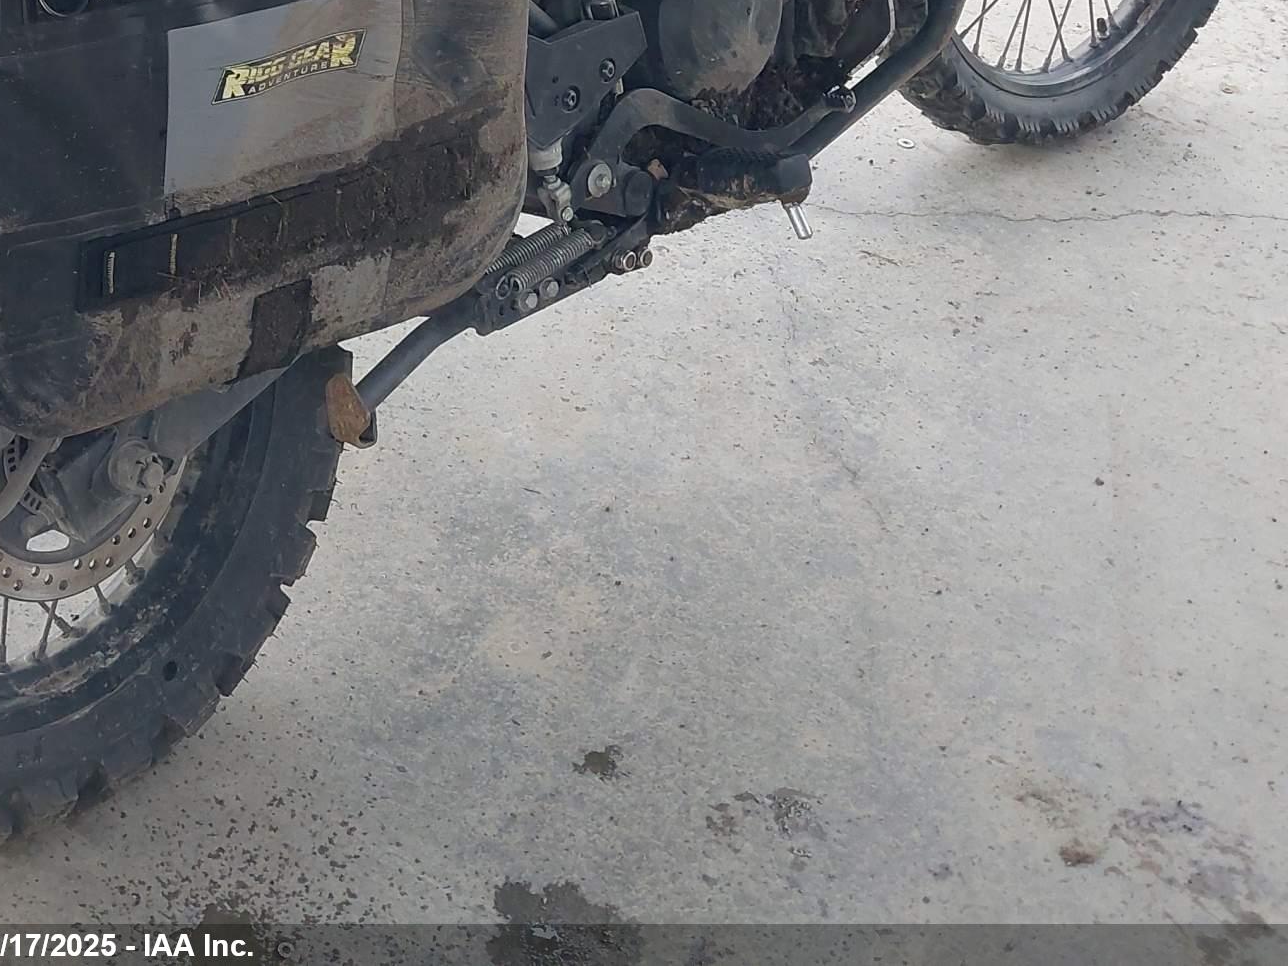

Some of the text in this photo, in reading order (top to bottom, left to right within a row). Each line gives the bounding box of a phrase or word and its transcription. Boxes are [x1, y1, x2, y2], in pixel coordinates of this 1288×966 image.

[222, 34, 355, 99] RIGG GEAR
[248, 61, 328, 94] ADVENTURE
